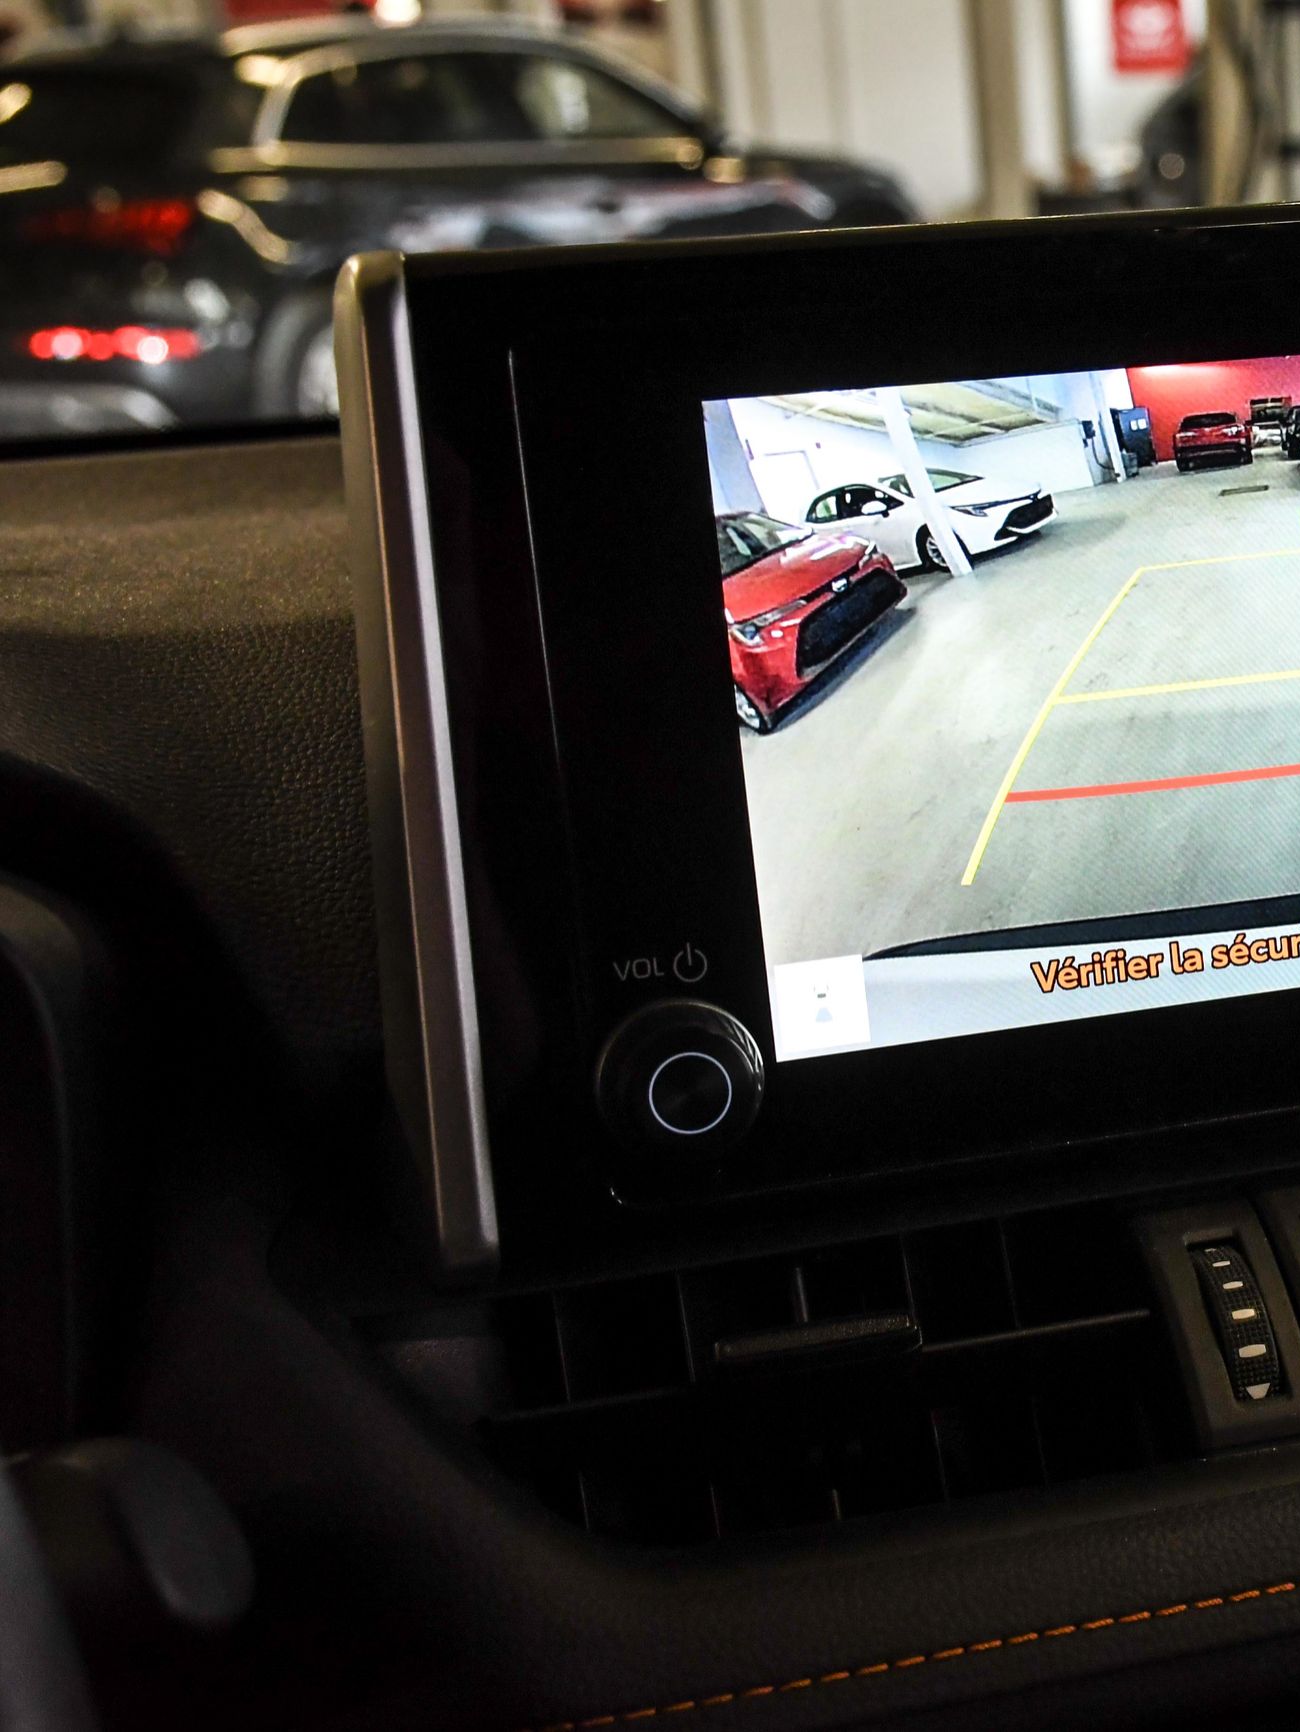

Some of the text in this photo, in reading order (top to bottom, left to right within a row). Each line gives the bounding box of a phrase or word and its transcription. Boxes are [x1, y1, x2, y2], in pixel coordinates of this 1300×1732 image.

[613, 957, 664, 981] VOL
[1031, 948, 1165, 993] Vérifier
[1169, 942, 1203, 975] la
